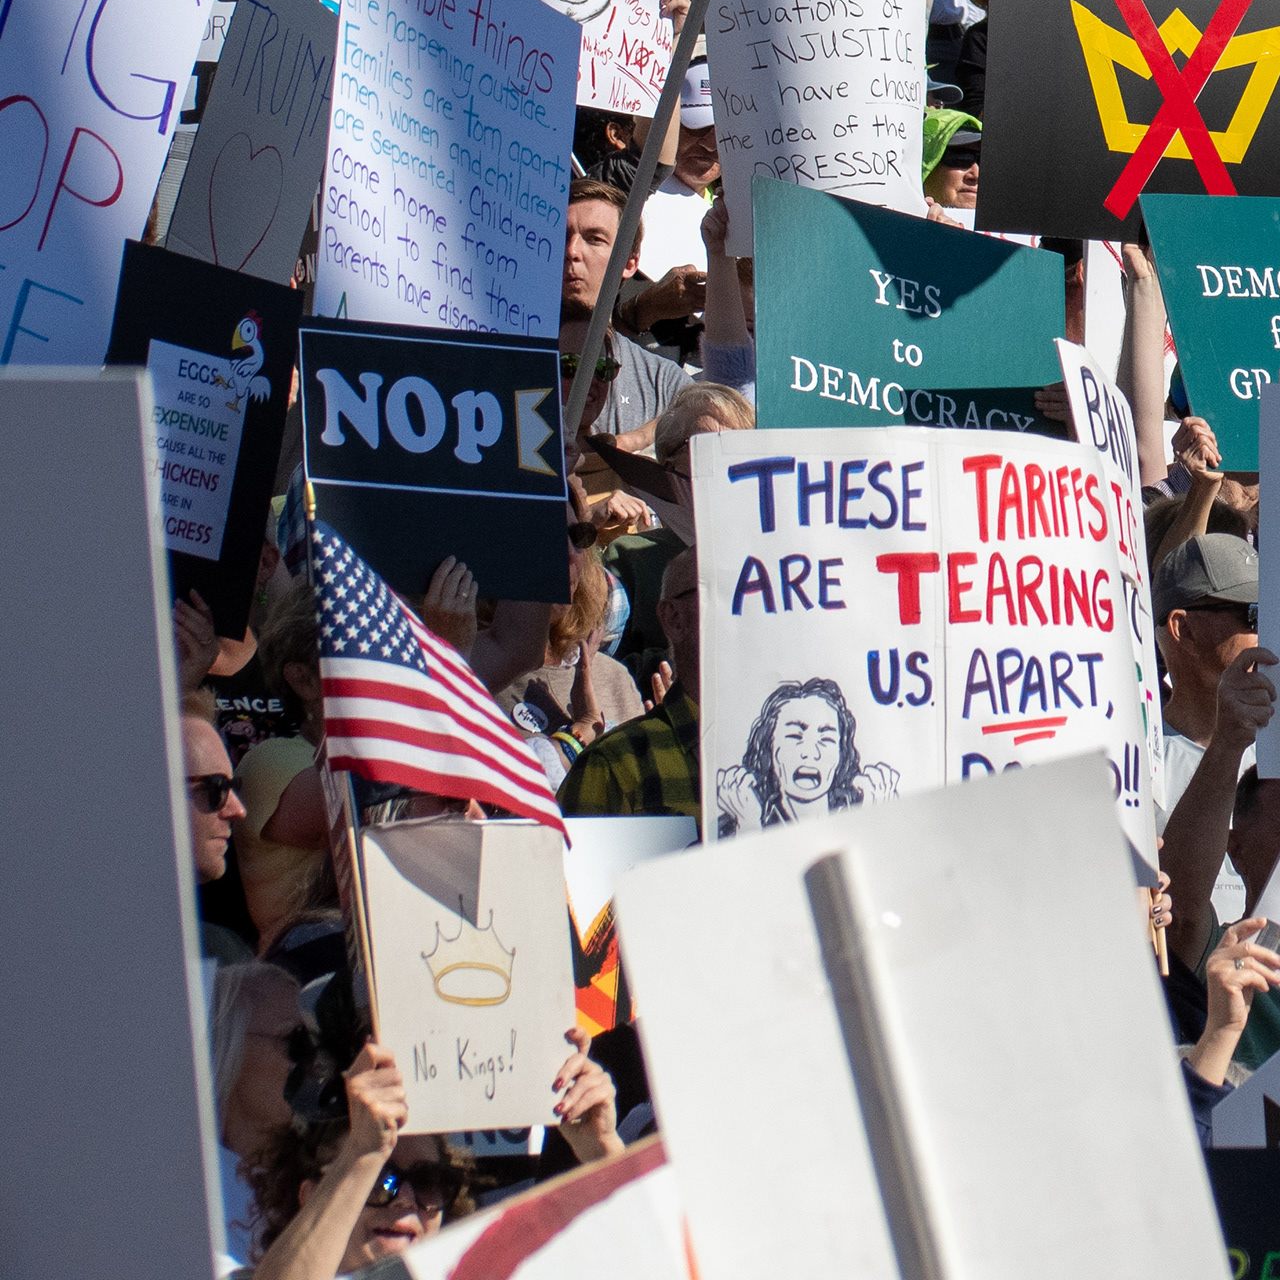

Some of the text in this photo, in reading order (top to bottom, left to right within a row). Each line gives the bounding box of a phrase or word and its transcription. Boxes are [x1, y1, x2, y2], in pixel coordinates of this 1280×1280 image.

[343, 20, 413, 101] Families
[778, 72, 922, 105] have chosen
[719, 115, 907, 153] the of the
[868, 269, 942, 319] YES
[892, 338, 923, 367] to
[177, 391, 196, 404] ARE
[208, 449, 227, 466] THE
[727, 453, 1109, 544] THESE TARIFFS
[731, 551, 1115, 633] ARE TEARING
[411, 1039, 439, 1082] No
